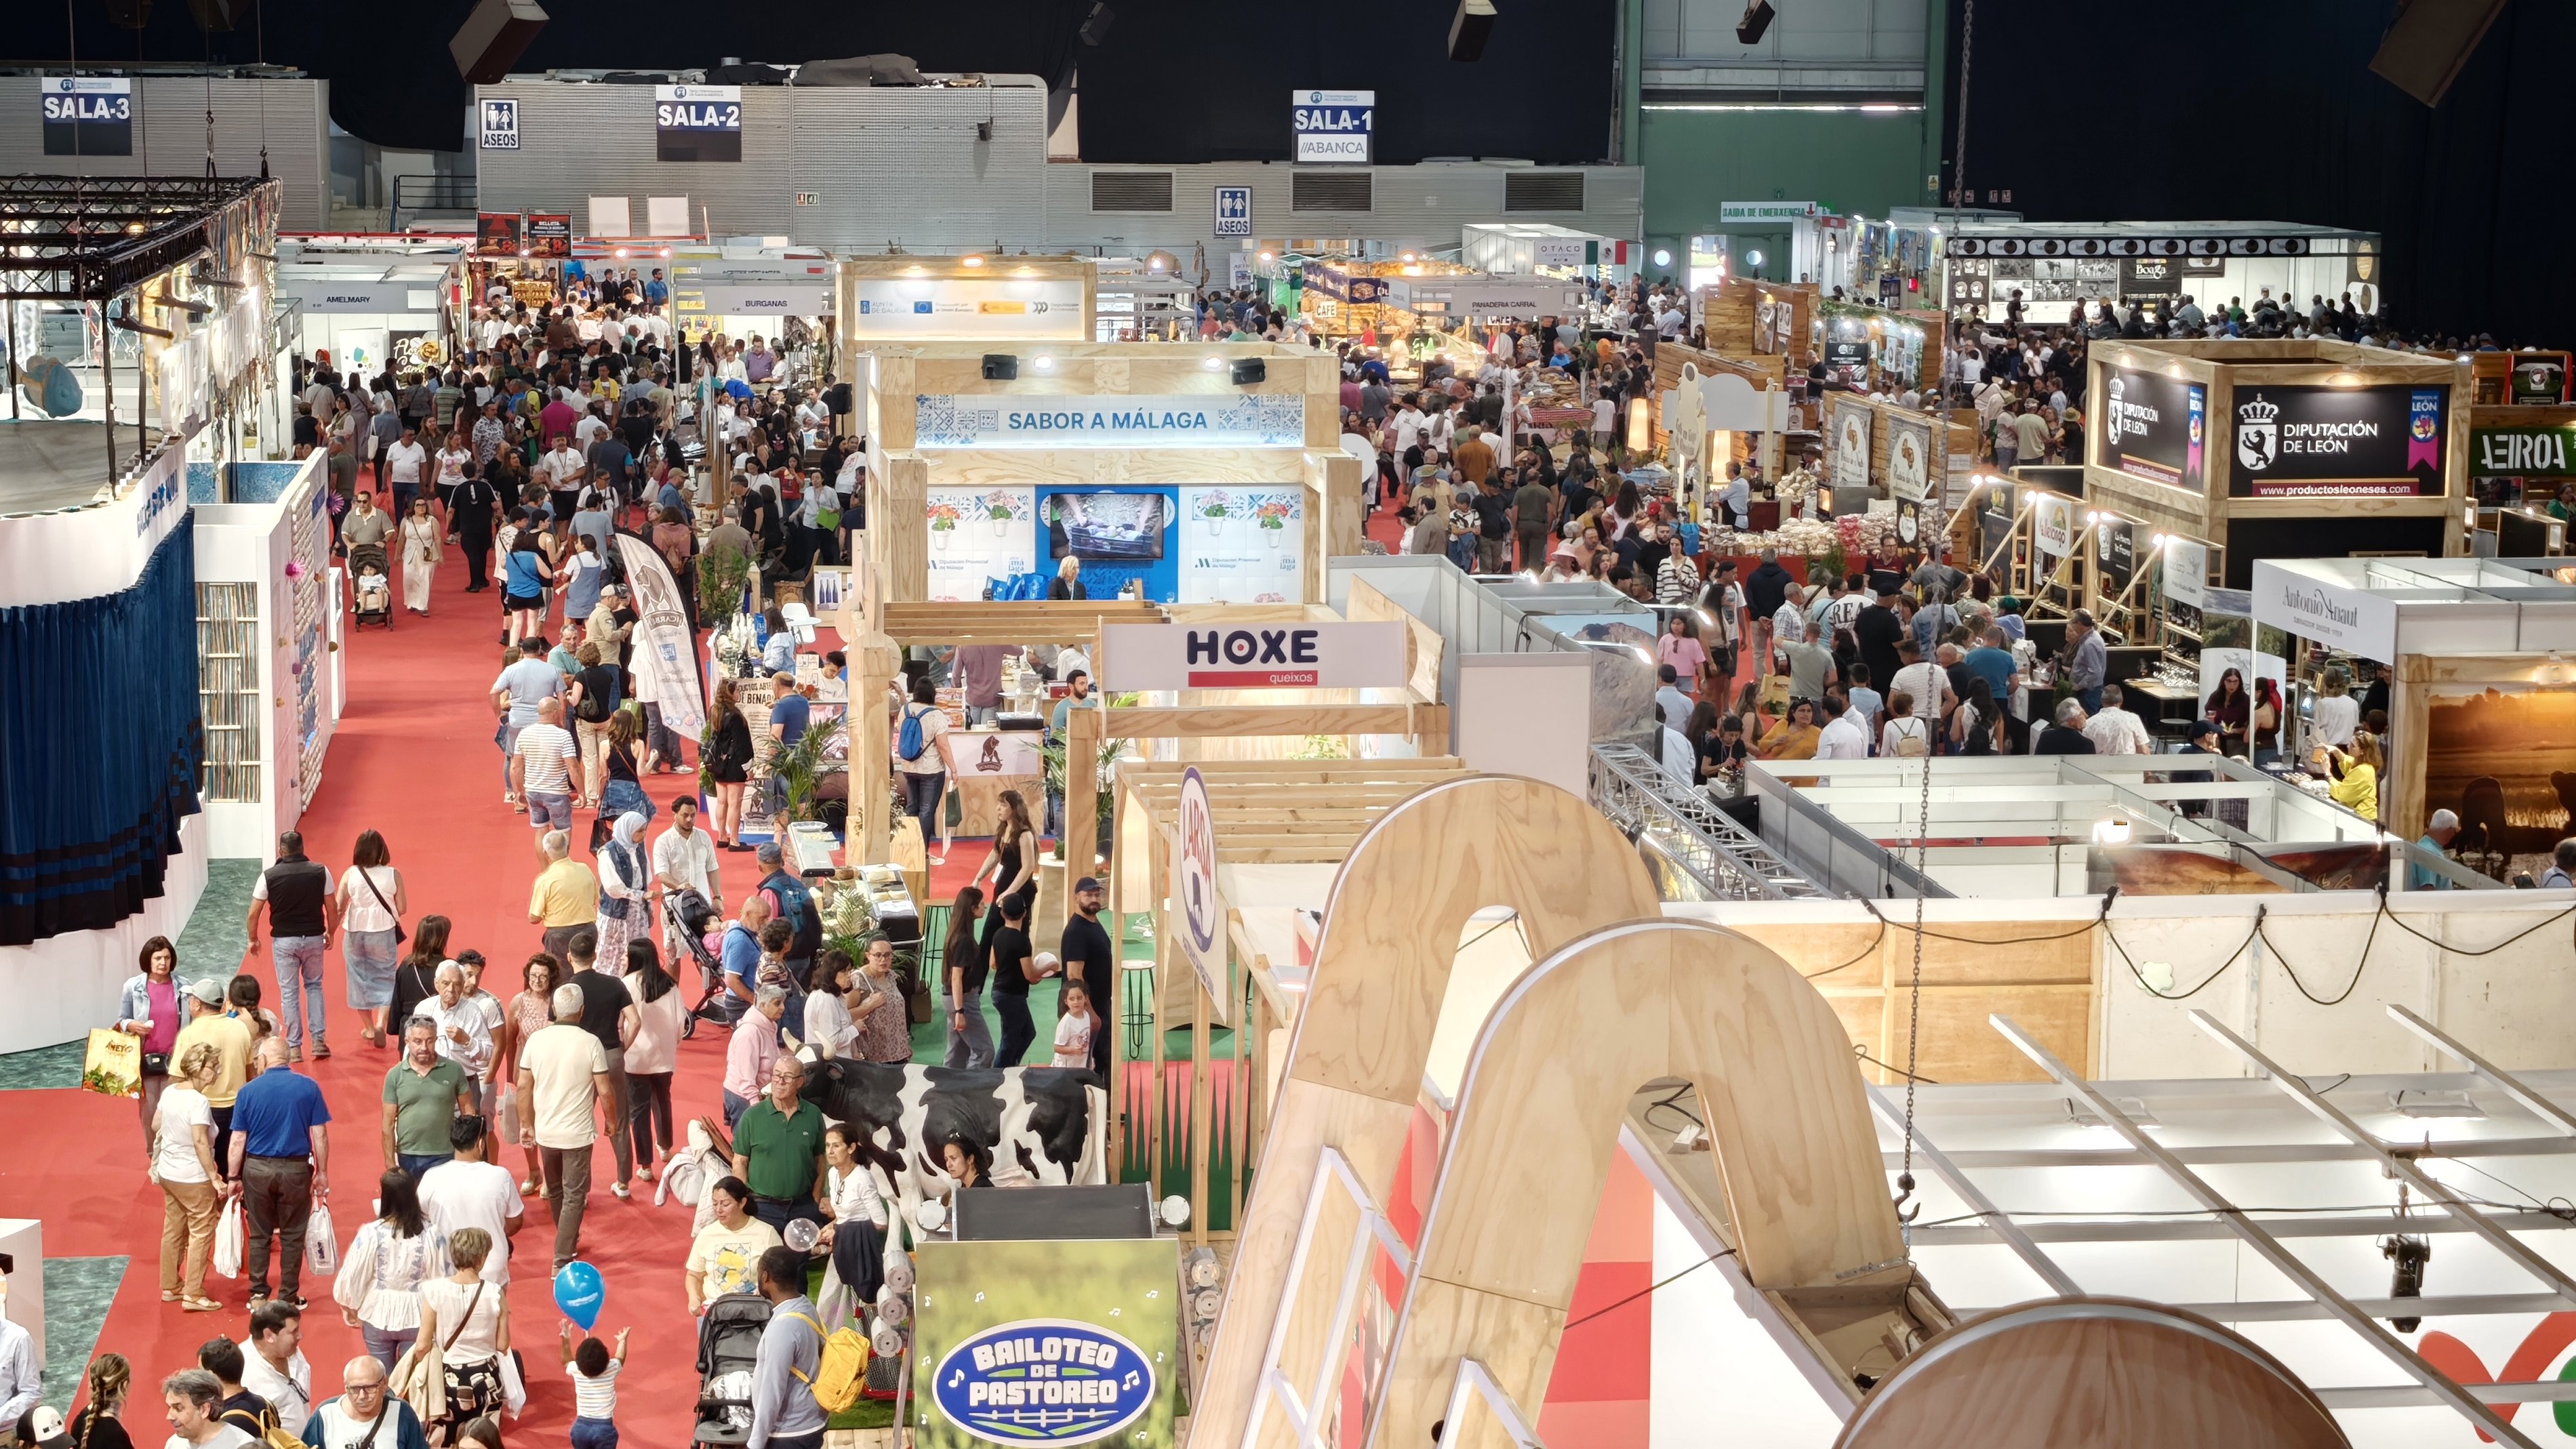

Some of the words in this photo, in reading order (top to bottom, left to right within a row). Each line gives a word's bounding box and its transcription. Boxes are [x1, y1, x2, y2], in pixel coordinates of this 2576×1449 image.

[44, 97, 130, 119] SALA-3
[658, 104, 740, 127] SALA-2
[1294, 109, 1372, 131] SALA-1
[483, 134, 517, 148] ASEOS
[1217, 220, 1249, 234] ASEOS
[1008, 412, 1084, 430] SABOR
[1090, 413, 1106, 429] A
[1112, 407, 1208, 430] MÁLAGA
[2124, 402, 2158, 422] DIPUTACIÓN
[2123, 419, 2131, 432] DE
[2131, 419, 2148, 436] LEÓN
[2283, 420, 2378, 437] DIPUTACIÓN
[2283, 440, 2302, 453] DE
[2307, 437, 2348, 453] LEÓN
[2260, 484, 2411, 496] www.productosleoneses.com
[2282, 585, 2323, 617] Antonio
[1187, 630, 1319, 665] HOXE
[1269, 672, 1313, 685] queixos
[747, 693, 773, 704] BENAO
[1182, 797, 1213, 905] LARSA
[971, 1336, 1118, 1371] BAILOTEO
[1030, 1364, 1058, 1378] DE
[969, 1379, 1118, 1407] PASTOREO
